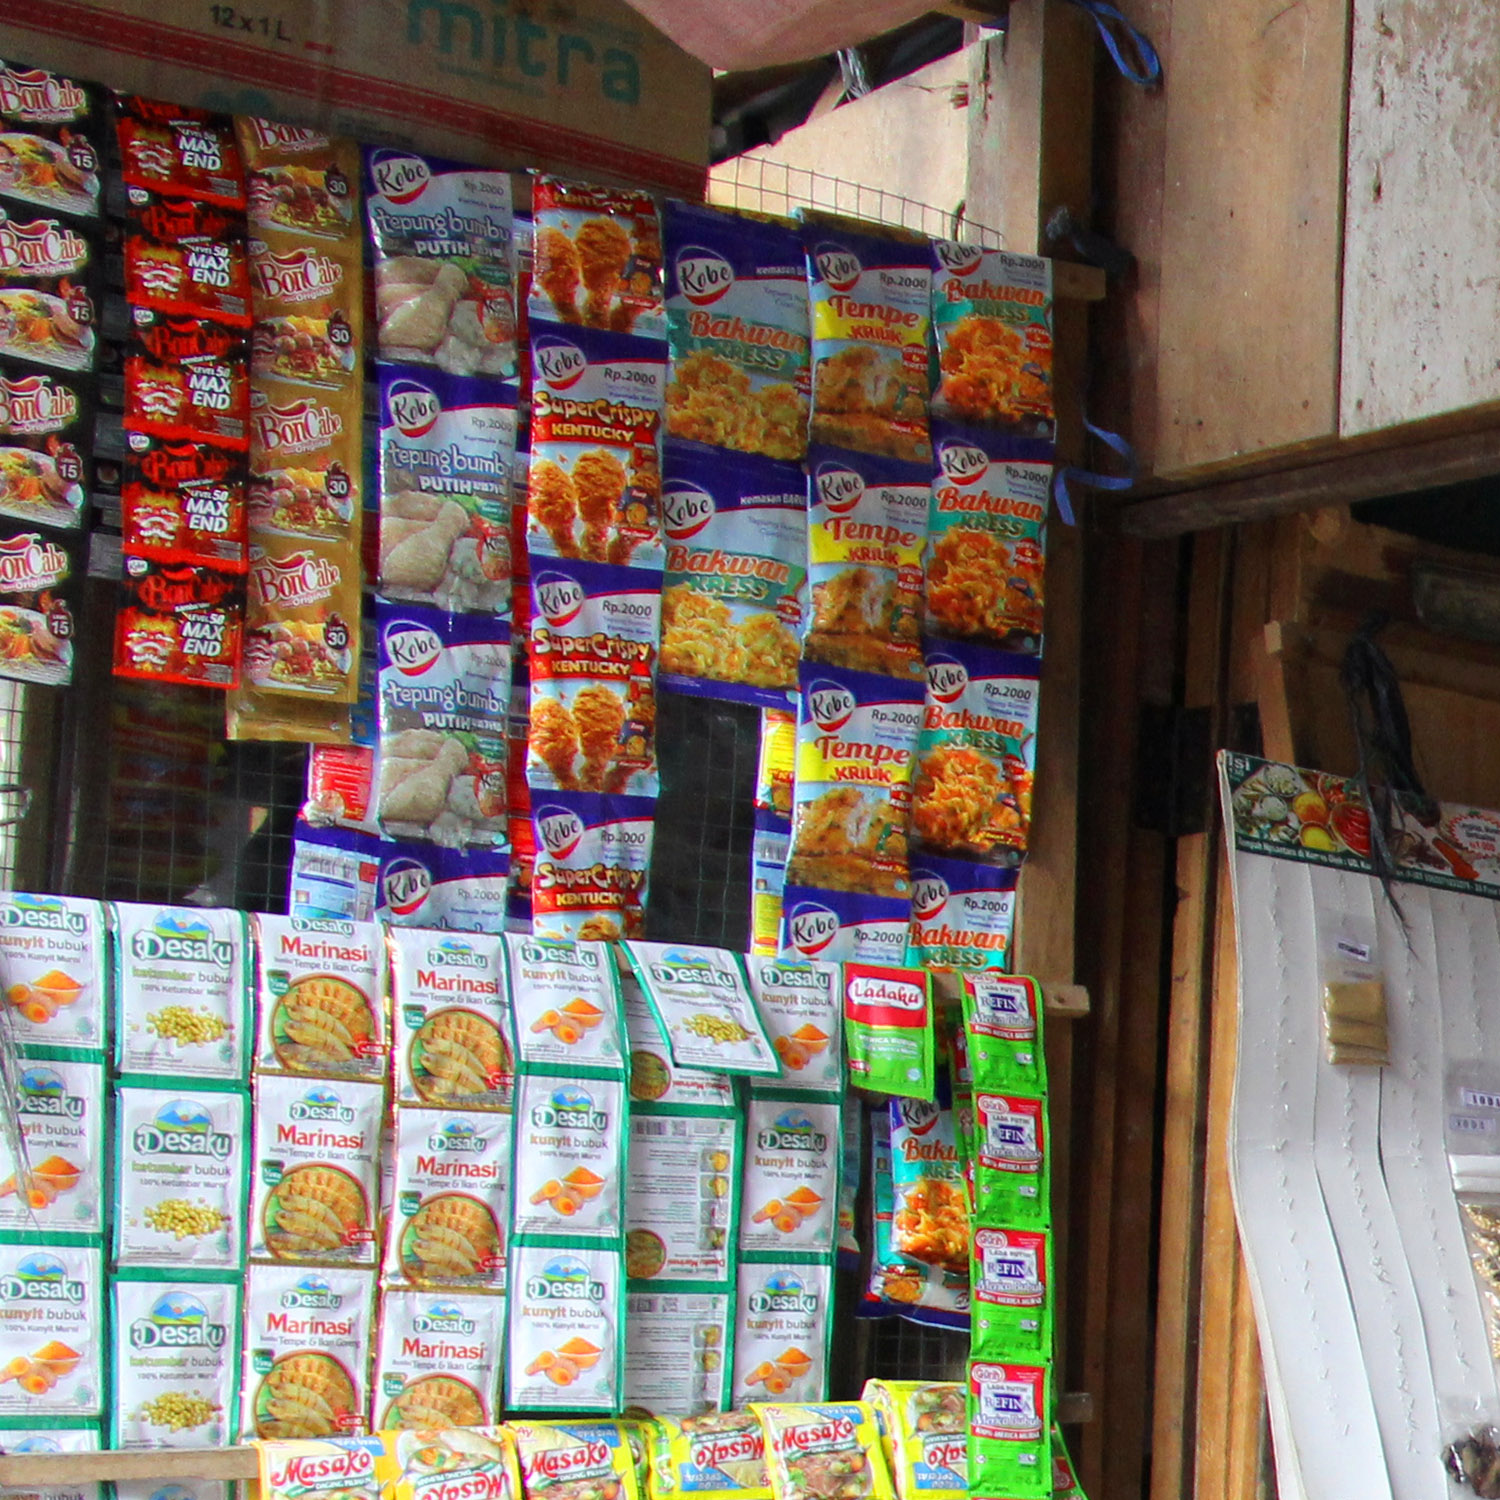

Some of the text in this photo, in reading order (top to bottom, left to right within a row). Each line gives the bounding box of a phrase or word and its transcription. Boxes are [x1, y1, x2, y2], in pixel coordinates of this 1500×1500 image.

[179, 135, 221, 159] MAX
[73, 153, 93, 170] 15
[182, 151, 222, 171] END
[375, 162, 426, 193] Kobe
[415, 240, 472, 256] PUTIH
[188, 252, 231, 273] MAX
[678, 259, 733, 290] Kobe
[191, 268, 231, 288] END
[258, 257, 343, 301] BonCabe
[879, 272, 928, 291] Rp.2000
[940, 278, 1045, 308] Bakwan
[826, 293, 919, 330] Tempe
[330, 327, 350, 345] 30
[689, 310, 806, 352] Bakwan
[603, 367, 658, 385] Rp.2000
[392, 398, 442, 427] Kobe
[258, 412, 343, 454] BonCabe
[551, 422, 636, 443] KENTUCKY
[418, 475, 473, 492] PUTIH
[935, 488, 1043, 520] Bakwan
[823, 516, 918, 549] Tempe
[665, 545, 790, 584] Bakwan
[600, 601, 652, 619] Rp.2000
[327, 630, 348, 647] 30
[389, 632, 440, 666] Kobe
[534, 629, 650, 660] SuperCrispy
[551, 660, 631, 676] KENTUCKY
[923, 704, 1024, 738] Bakwan
[813, 736, 911, 765] Tempe
[833, 765, 892, 783] KRIUK
[48, 935, 88, 950] bubuk
[135, 931, 231, 966] Desaku
[281, 936, 368, 961] Marinasi
[524, 942, 597, 966] Desaku
[430, 951, 487, 968] Desaku
[417, 970, 499, 994] Marinasi
[652, 964, 735, 988] Desaku
[292, 1104, 352, 1120] Desaku
[277, 1124, 364, 1149] Marinasi
[417, 1157, 497, 1177] Marinasi
[271, 1449, 371, 1487] Masako
